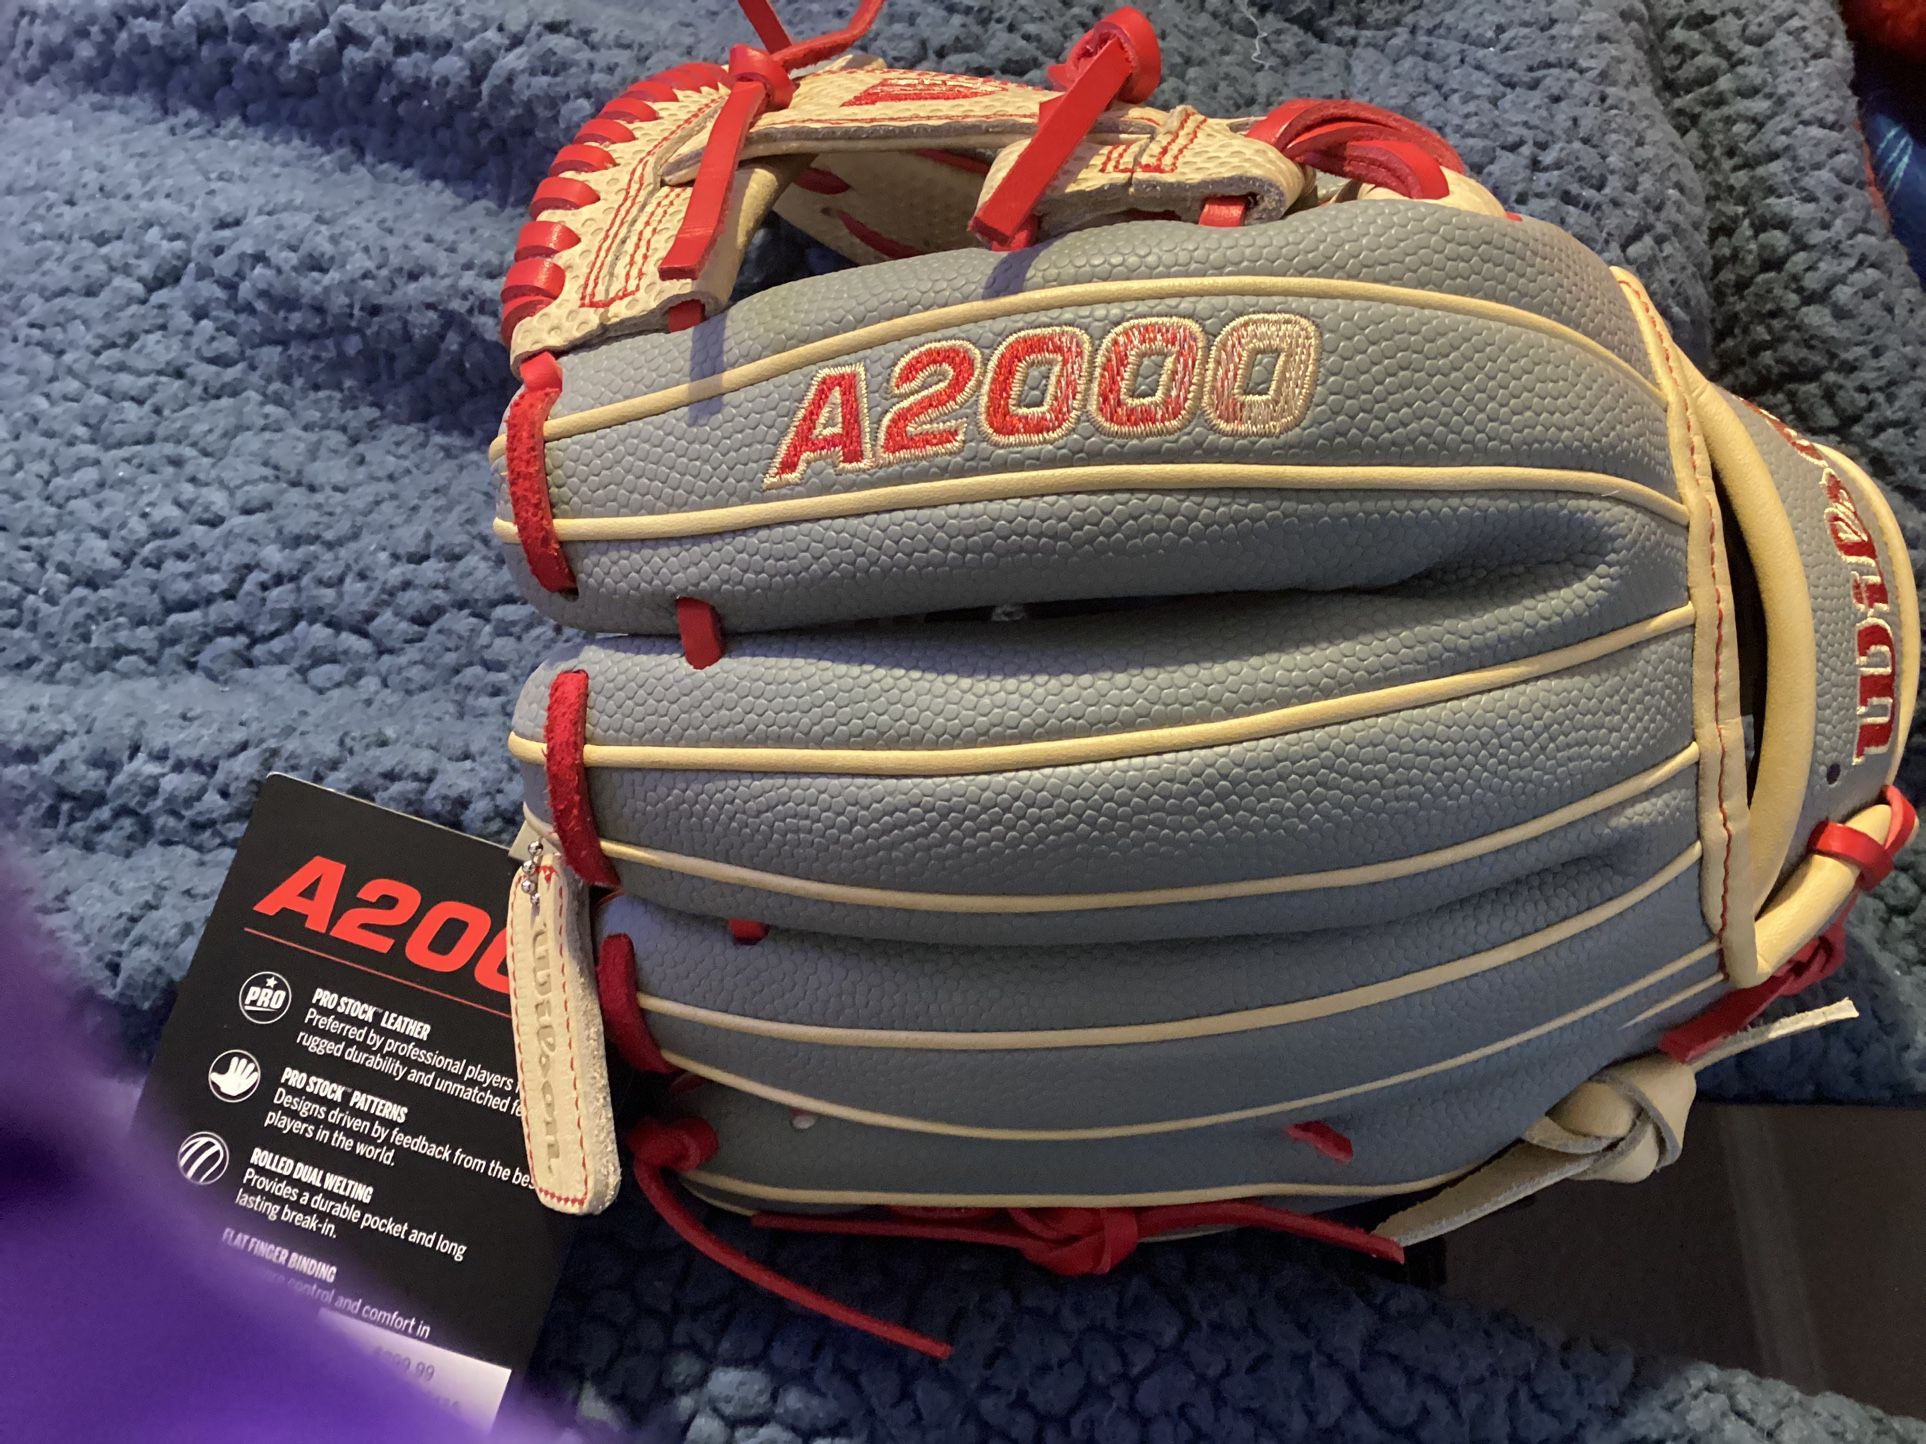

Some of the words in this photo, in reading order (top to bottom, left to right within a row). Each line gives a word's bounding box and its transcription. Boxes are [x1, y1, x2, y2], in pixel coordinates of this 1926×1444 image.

[762, 312, 1321, 491] A2000
[252, 855, 512, 995] A20
[245, 987, 287, 1010] PRO
[311, 987, 339, 1010] PRO
[380, 1010, 431, 1041] LEATHER
[296, 1031, 346, 1057] rugged
[344, 1044, 408, 1081] durability
[406, 1069, 436, 1088] and
[434, 1077, 512, 1113] unmatched
[304, 1007, 368, 1042] Preferred
[366, 1028, 385, 1051] by
[382, 1038, 467, 1075] professional
[463, 1063, 514, 1091] players
[280, 1066, 308, 1089] PRO
[349, 1090, 409, 1124] PATTERNS
[263, 1110, 315, 1138] players
[315, 1124, 330, 1144] in
[330, 1129, 354, 1152] the
[355, 1141, 396, 1167] world.
[273, 1087, 327, 1120] Designs
[327, 1107, 371, 1135] driven
[370, 1120, 390, 1143] by
[389, 1127, 452, 1162] feedback
[452, 1148, 487, 1173] from
[487, 1159, 511, 1181] the
[249, 1147, 295, 1176] ROLLED
[292, 1161, 324, 1188] DUAL
[323, 1172, 374, 1204] WELTING
[235, 1187, 281, 1221] lasting
[280, 1204, 337, 1239] break-in.
[242, 1167, 299, 1201] Provides
[299, 1191, 310, 1205] a
[310, 1192, 361, 1223] durable
[360, 1213, 409, 1240] pocket
[408, 1229, 437, 1248] and
[435, 1233, 467, 1262] long
[247, 1237, 289, 1265] FINGER
[287, 1252, 337, 1283] BINDING
[288, 1279, 336, 1304] control
[334, 1295, 363, 1315] and
[361, 1305, 416, 1334] comfort
[415, 1320, 431, 1339] in
